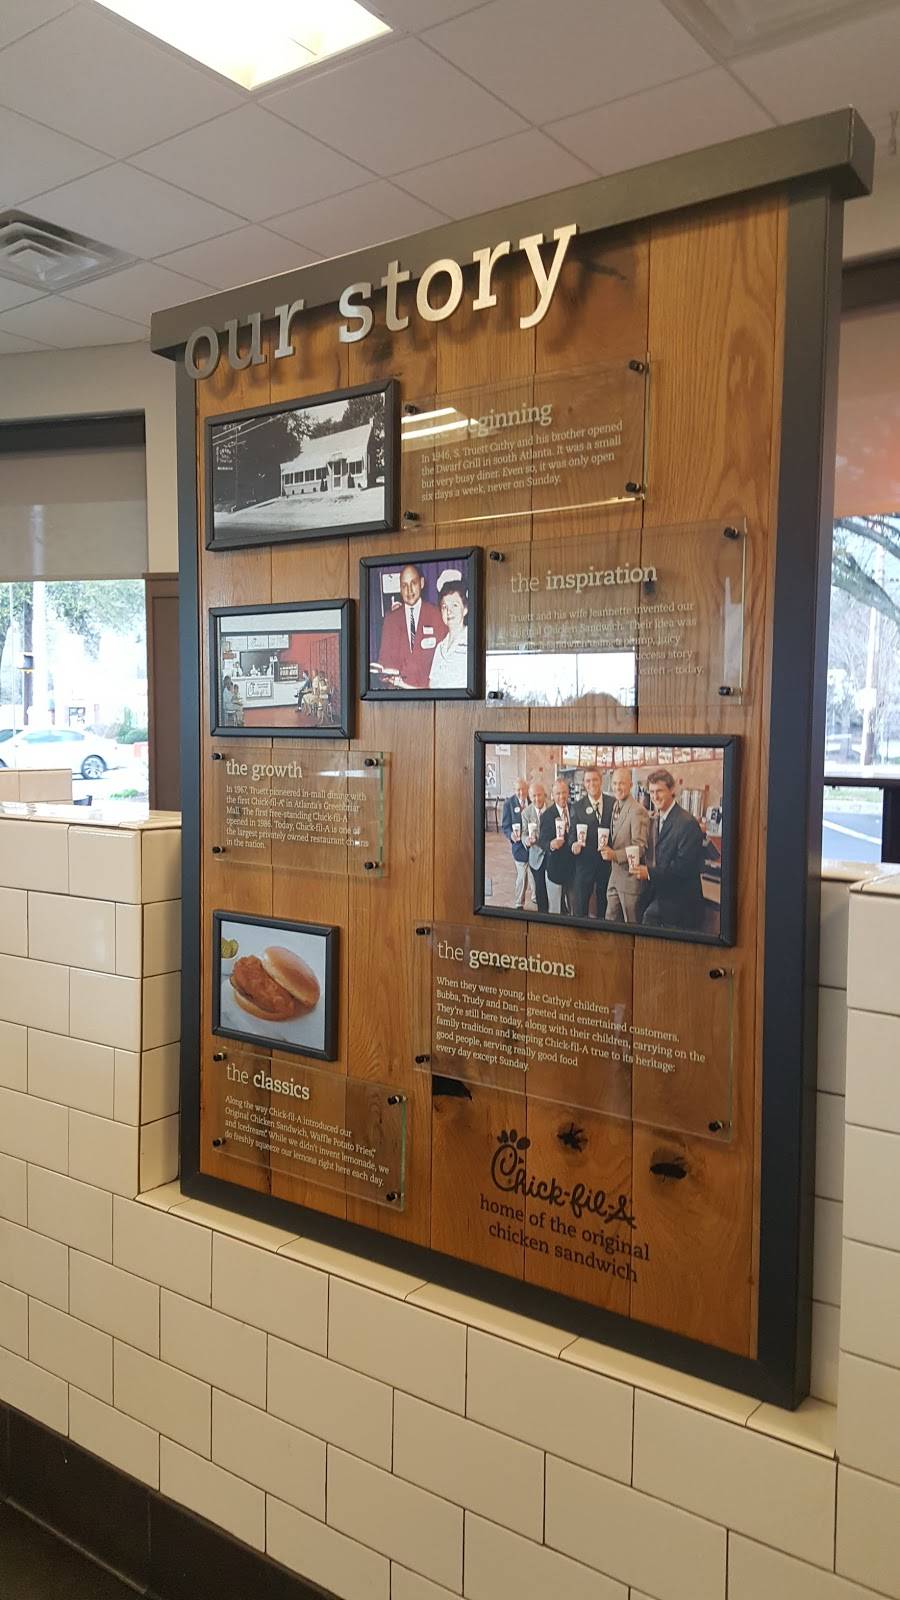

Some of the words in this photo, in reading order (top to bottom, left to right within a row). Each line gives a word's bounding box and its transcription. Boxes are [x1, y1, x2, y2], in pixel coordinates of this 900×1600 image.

[184, 299, 305, 380] our
[338, 223, 578, 343] story
[421, 467, 434, 477] the
[436, 461, 460, 473] Dwarf
[462, 458, 480, 470] Grill
[482, 458, 491, 466] in
[494, 452, 518, 464] south
[519, 448, 554, 460] Atlanta.
[565, 444, 584, 454] was
[594, 434, 622, 449] small
[422, 454, 430, 464] In
[432, 450, 452, 462] 1946,
[464, 446, 488, 457] Truett
[489, 440, 516, 452] Cathy
[517, 436, 534, 448] and
[536, 434, 550, 445] his
[552, 428, 586, 442] brother
[588, 420, 623, 438] opened
[421, 492, 434, 502] six
[434, 490, 454, 502] days
[462, 486, 486, 496] week,
[487, 482, 512, 492] never
[513, 480, 525, 488] on
[526, 474, 561, 487] Sunday.
[422, 479, 434, 488] but
[436, 478, 454, 488] very
[456, 473, 476, 485] busy
[476, 469, 500, 480] diner.
[502, 466, 524, 478] Even
[526, 465, 538, 474] so,
[548, 460, 566, 470] was
[568, 455, 589, 470] only
[591, 452, 615, 466] open
[510, 572, 540, 594] the
[545, 562, 658, 594] inspiration
[553, 610, 567, 620] his
[568, 607, 588, 618] wife
[634, 602, 675, 614] invented
[677, 602, 696, 611] our
[677, 618, 697, 627] was
[226, 758, 248, 776] the
[252, 760, 303, 782] growth
[226, 784, 232, 793] In
[250, 786, 269, 796] Truett
[269, 788, 300, 798] pioneered
[302, 788, 326, 799] in-mall
[327, 791, 350, 802] dining
[350, 792, 367, 801] with
[226, 795, 237, 804] the
[237, 796, 250, 805] first
[294, 800, 322, 810] Atlanta's
[226, 818, 248, 828] opened
[274, 820, 295, 832] Today,
[296, 822, 330, 834] Chick-fil-A
[242, 807, 254, 816] The
[255, 808, 268, 817] first
[269, 808, 312, 822] free-standing
[313, 812, 348, 823] Chick-fil-A
[226, 827, 236, 835] the
[237, 828, 258, 840] largest
[258, 830, 286, 842] privately
[287, 833, 309, 842] owned
[310, 836, 344, 846] restaurant
[234, 838, 244, 847] the
[244, 840, 266, 849] nation.
[437, 940, 464, 962] the
[469, 948, 576, 978] generations
[436, 976, 458, 989] When
[460, 980, 477, 992] they
[478, 985, 498, 994] were
[499, 988, 525, 1001] young,
[527, 992, 540, 1002] the
[542, 994, 572, 1009] Cathys'
[574, 1000, 610, 1014] children
[436, 990, 460, 1003] Bubba,
[462, 994, 484, 1008] Trudy
[486, 1000, 500, 1009] and
[502, 1002, 518, 1012] Dan
[526, 1006, 557, 1020] greeted
[559, 1013, 575, 1022] and
[576, 1016, 627, 1033] entertained
[629, 1026, 680, 1042] customers.
[437, 1002, 464, 1016] They're
[465, 1008, 480, 1018] still
[481, 1011, 498, 1022] here
[500, 1016, 523, 1028] today,
[524, 1020, 548, 1034] along
[548, 1024, 568, 1036] with
[570, 1028, 590, 1040] their
[592, 1032, 631, 1050] children,
[632, 1040, 673, 1058] carrying
[674, 1050, 687, 1059] on
[689, 1050, 706, 1064] the
[436, 1016, 460, 1030] family
[461, 1022, 494, 1035] tradition
[496, 1029, 510, 1038] and
[512, 1030, 544, 1047] keeping
[544, 1036, 589, 1054] Chick-fil-A
[591, 1048, 610, 1059] true
[611, 1050, 620, 1060] to
[622, 1052, 634, 1064] its
[636, 1054, 676, 1074] heritage:
[436, 1031, 454, 1040] good
[456, 1034, 482, 1047] people,
[483, 1040, 513, 1055] serving
[513, 1045, 536, 1058] really
[537, 1051, 558, 1062] good
[560, 1054, 578, 1067] food
[436, 1044, 457, 1056] every
[458, 1047, 472, 1060] day
[472, 1052, 498, 1064] except
[499, 1056, 530, 1072] Sunday.
[226, 1062, 249, 1084] the
[253, 1070, 311, 1101] classics
[225, 1106, 250, 1120] Original
[250, 1114, 274, 1128] Chicken
[310, 1130, 332, 1145] Waffle
[333, 1137, 354, 1151] Potato
[226, 1095, 243, 1109] Along
[244, 1100, 254, 1110] the
[254, 1104, 268, 1116] way
[268, 1107, 302, 1123] Chick-fil-A
[304, 1116, 338, 1134] introduced
[340, 1129, 352, 1138] our
[224, 1120, 237, 1128] and
[268, 1130, 288, 1142] While
[288, 1138, 298, 1147] we
[299, 1140, 318, 1153] didn't
[320, 1146, 340, 1160] invent
[342, 1152, 377, 1172] lemonade,
[378, 1164, 390, 1175] we
[224, 1130, 232, 1139] do
[234, 1132, 254, 1147] freshly
[256, 1140, 280, 1154] squeeze
[281, 1148, 292, 1157] our
[294, 1150, 318, 1165] lemons
[318, 1158, 334, 1170] right
[335, 1162, 350, 1177] here
[352, 1168, 368, 1182] each
[370, 1174, 384, 1188] day.
[491, 1128, 638, 1230] Chick-fil-A
[480, 1193, 524, 1222] home
[528, 1212, 547, 1228] of
[550, 1214, 577, 1238] the
[582, 1228, 651, 1262] original
[488, 1222, 550, 1255] chicken
[554, 1244, 638, 1283] sandwich
